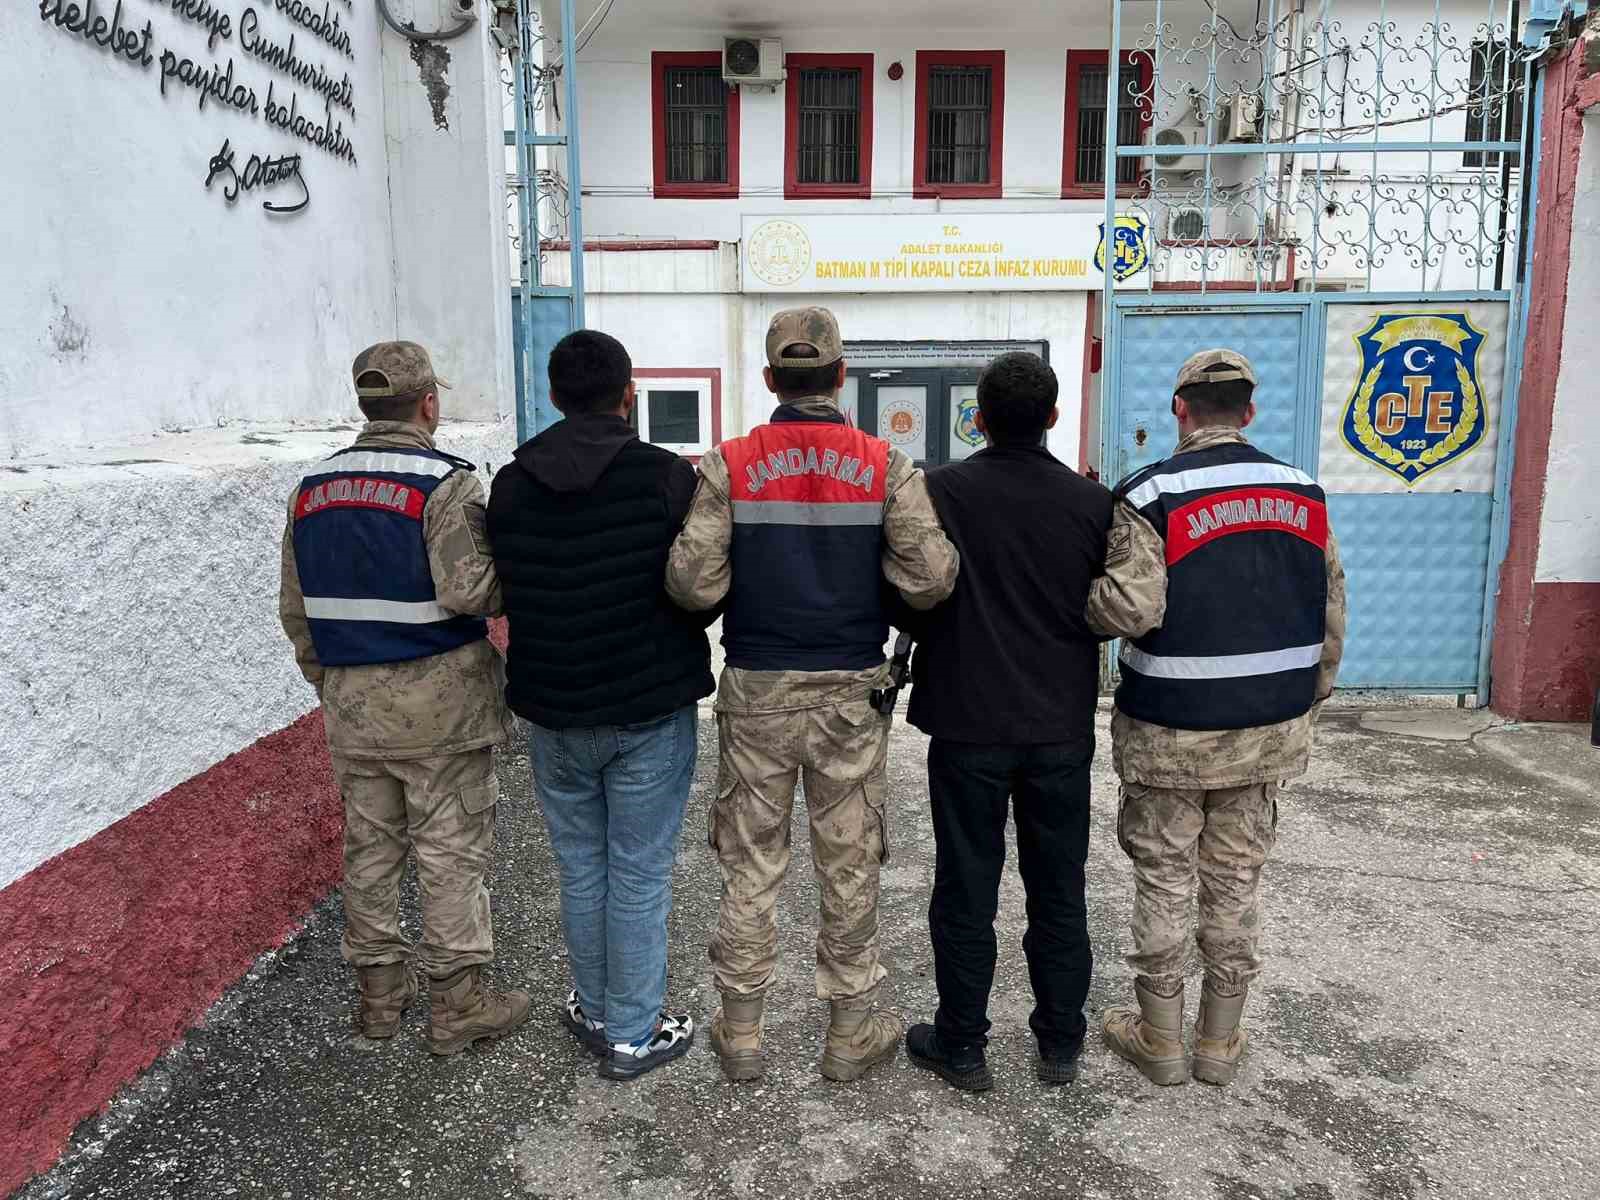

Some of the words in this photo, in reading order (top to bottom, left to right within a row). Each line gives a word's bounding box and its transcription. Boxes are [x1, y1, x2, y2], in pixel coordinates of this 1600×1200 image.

[160, 48, 259, 114] payidar
[943, 226, 961, 236] T.C.
[899, 244, 941, 255] ADALET
[944, 242, 1004, 254] BAKANLIĞI
[816, 260, 866, 278] BATMAN
[870, 260, 880, 277] M
[884, 256, 906, 277] TİPİ
[911, 259, 954, 277] KAPALI
[958, 259, 991, 277] CEZA
[994, 255, 1030, 276] İNFAZ
[1033, 258, 1087, 276] KURUMU
[1374, 375, 1454, 436] CTE
[1400, 439, 1427, 450] 1923
[745, 446, 875, 493] JANDARMA
[304, 479, 410, 512] JANDARMA
[1186, 497, 1309, 540] JANDARMA
